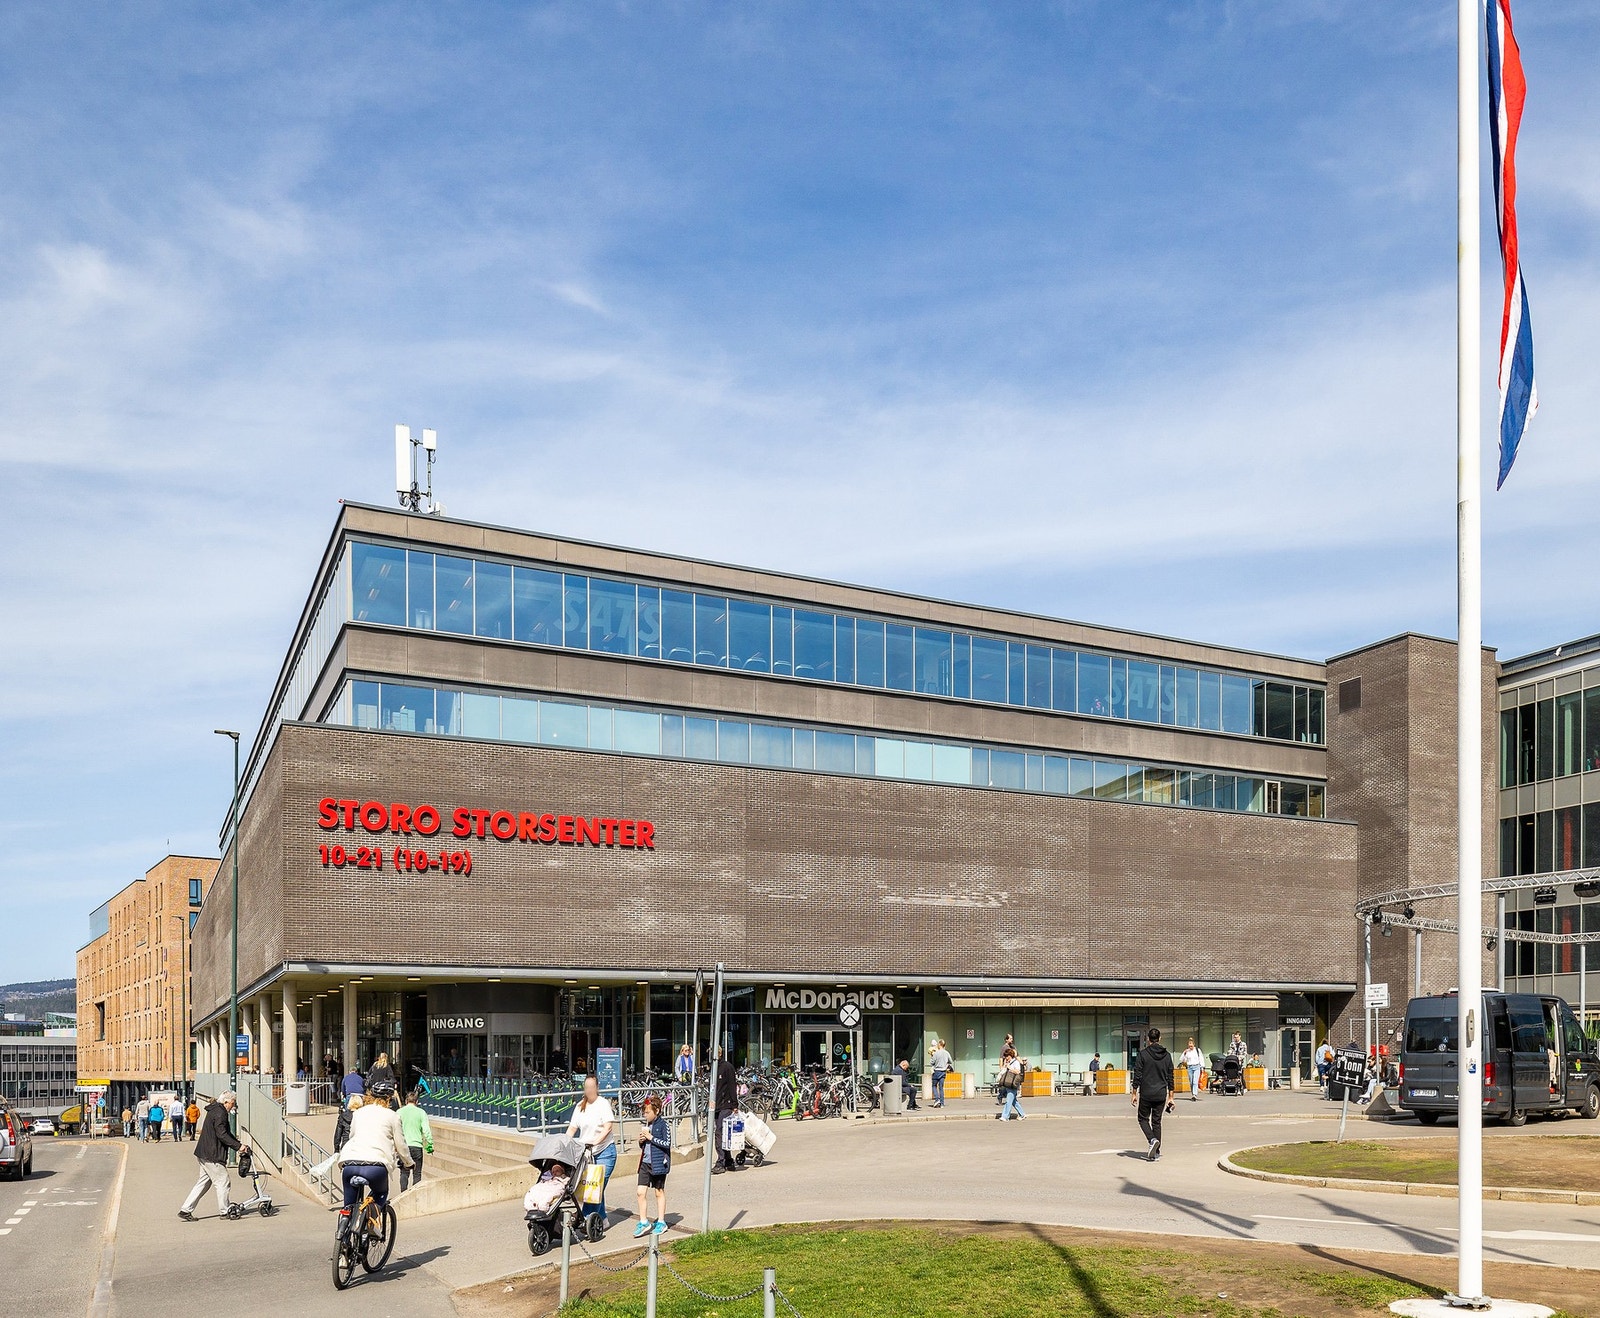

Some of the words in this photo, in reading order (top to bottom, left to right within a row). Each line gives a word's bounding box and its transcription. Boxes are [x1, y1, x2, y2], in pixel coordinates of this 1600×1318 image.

[553, 590, 665, 643] SATS
[1105, 672, 1179, 712] SATS
[317, 797, 442, 835] STORO
[452, 807, 656, 848] STORSENTER
[319, 844, 383, 868] 10-21
[392, 845, 473, 874] (10-19)
[765, 988, 895, 1010] McDonald's
[430, 1017, 485, 1029] INNGANG
